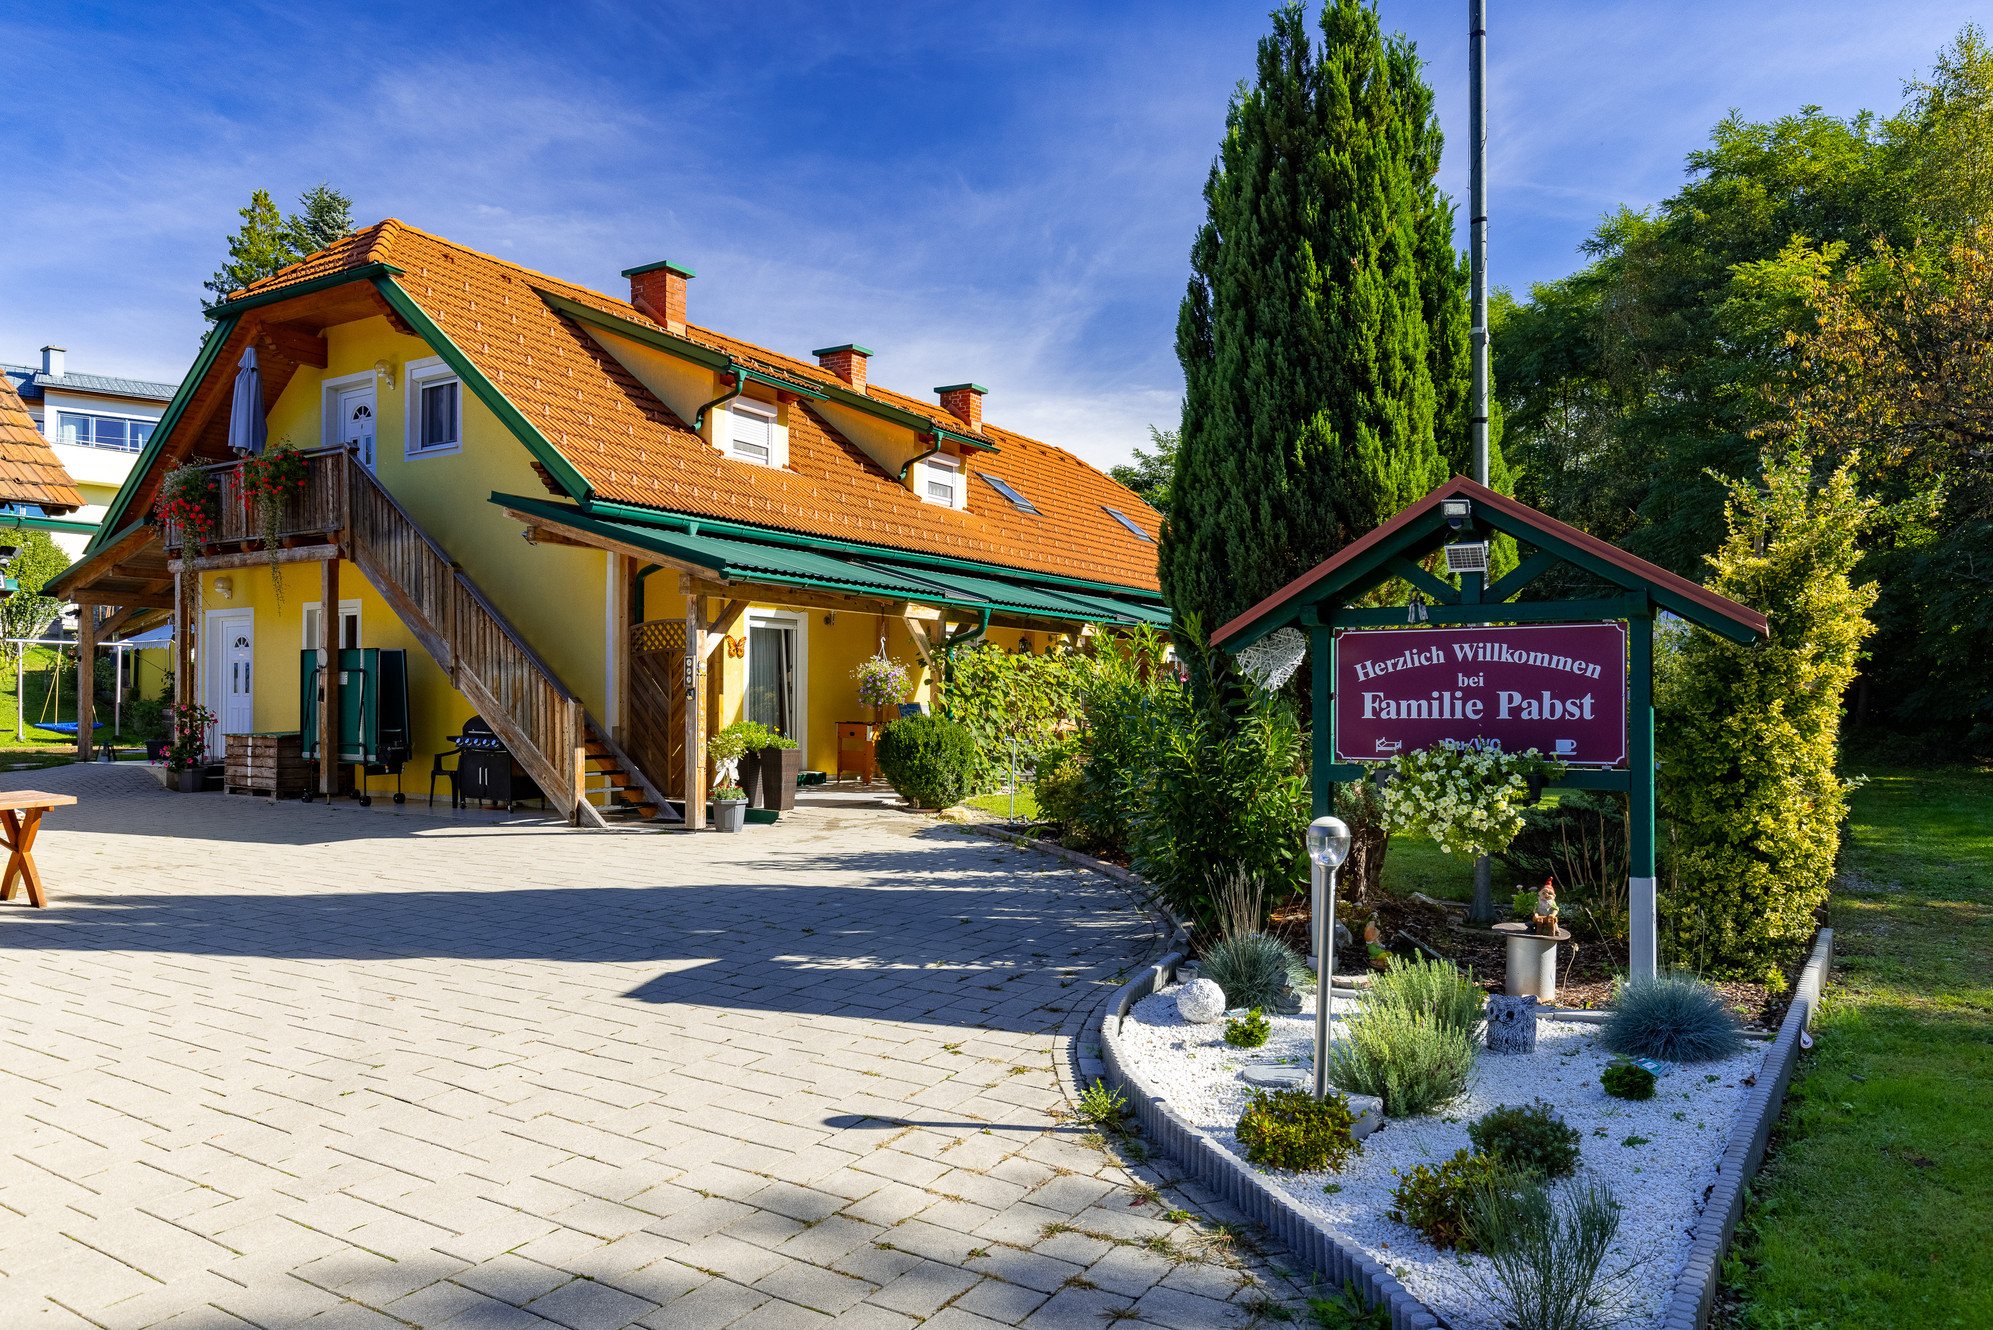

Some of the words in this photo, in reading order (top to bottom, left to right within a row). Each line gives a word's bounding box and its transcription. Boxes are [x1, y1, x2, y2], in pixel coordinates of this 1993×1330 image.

[1353, 646, 1446, 682] Herzlich
[1452, 642, 1602, 679] Willkommen
[1457, 672, 1484, 687] bei
[1361, 691, 1484, 719] Familie
[1496, 691, 1595, 720] Pabst
